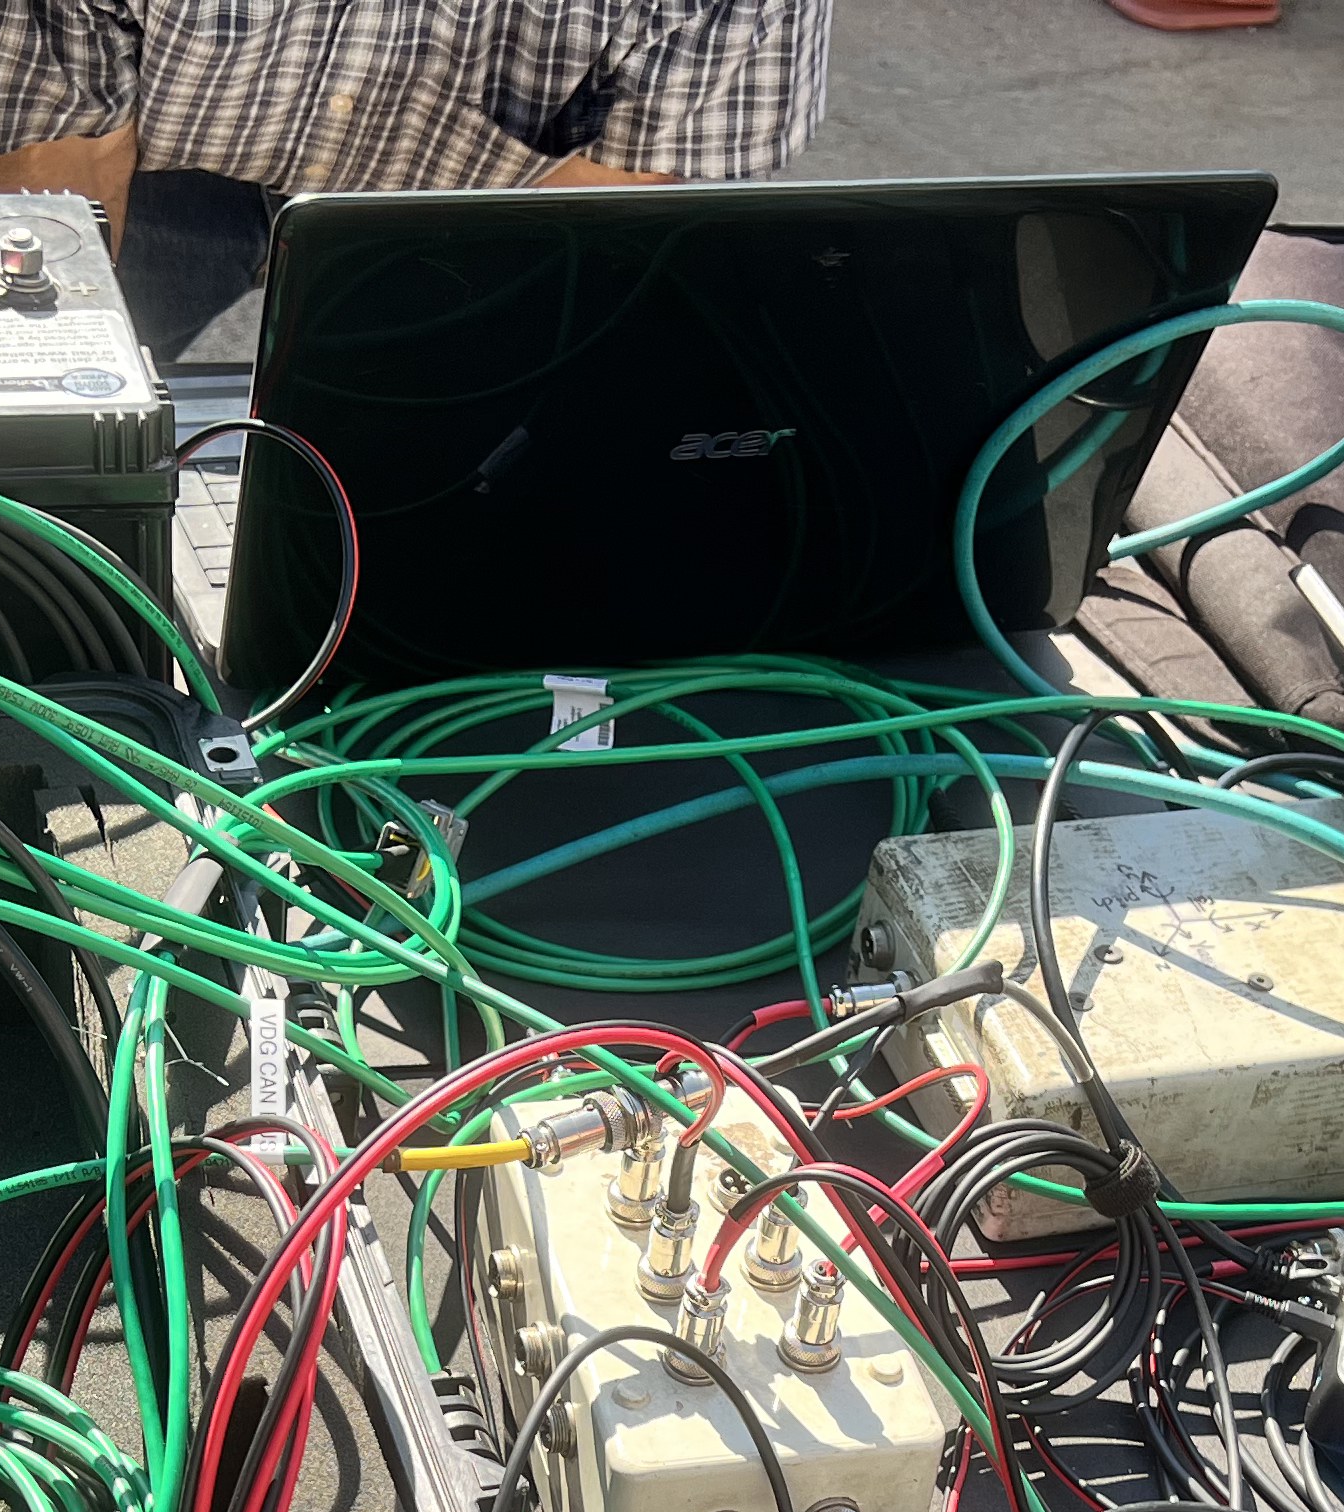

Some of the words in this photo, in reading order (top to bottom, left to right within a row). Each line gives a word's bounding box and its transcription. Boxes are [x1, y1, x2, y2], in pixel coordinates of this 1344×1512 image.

[670, 427, 797, 462] acer
[259, 1013, 277, 1056] VDG
[259, 1062, 278, 1103] CAN
